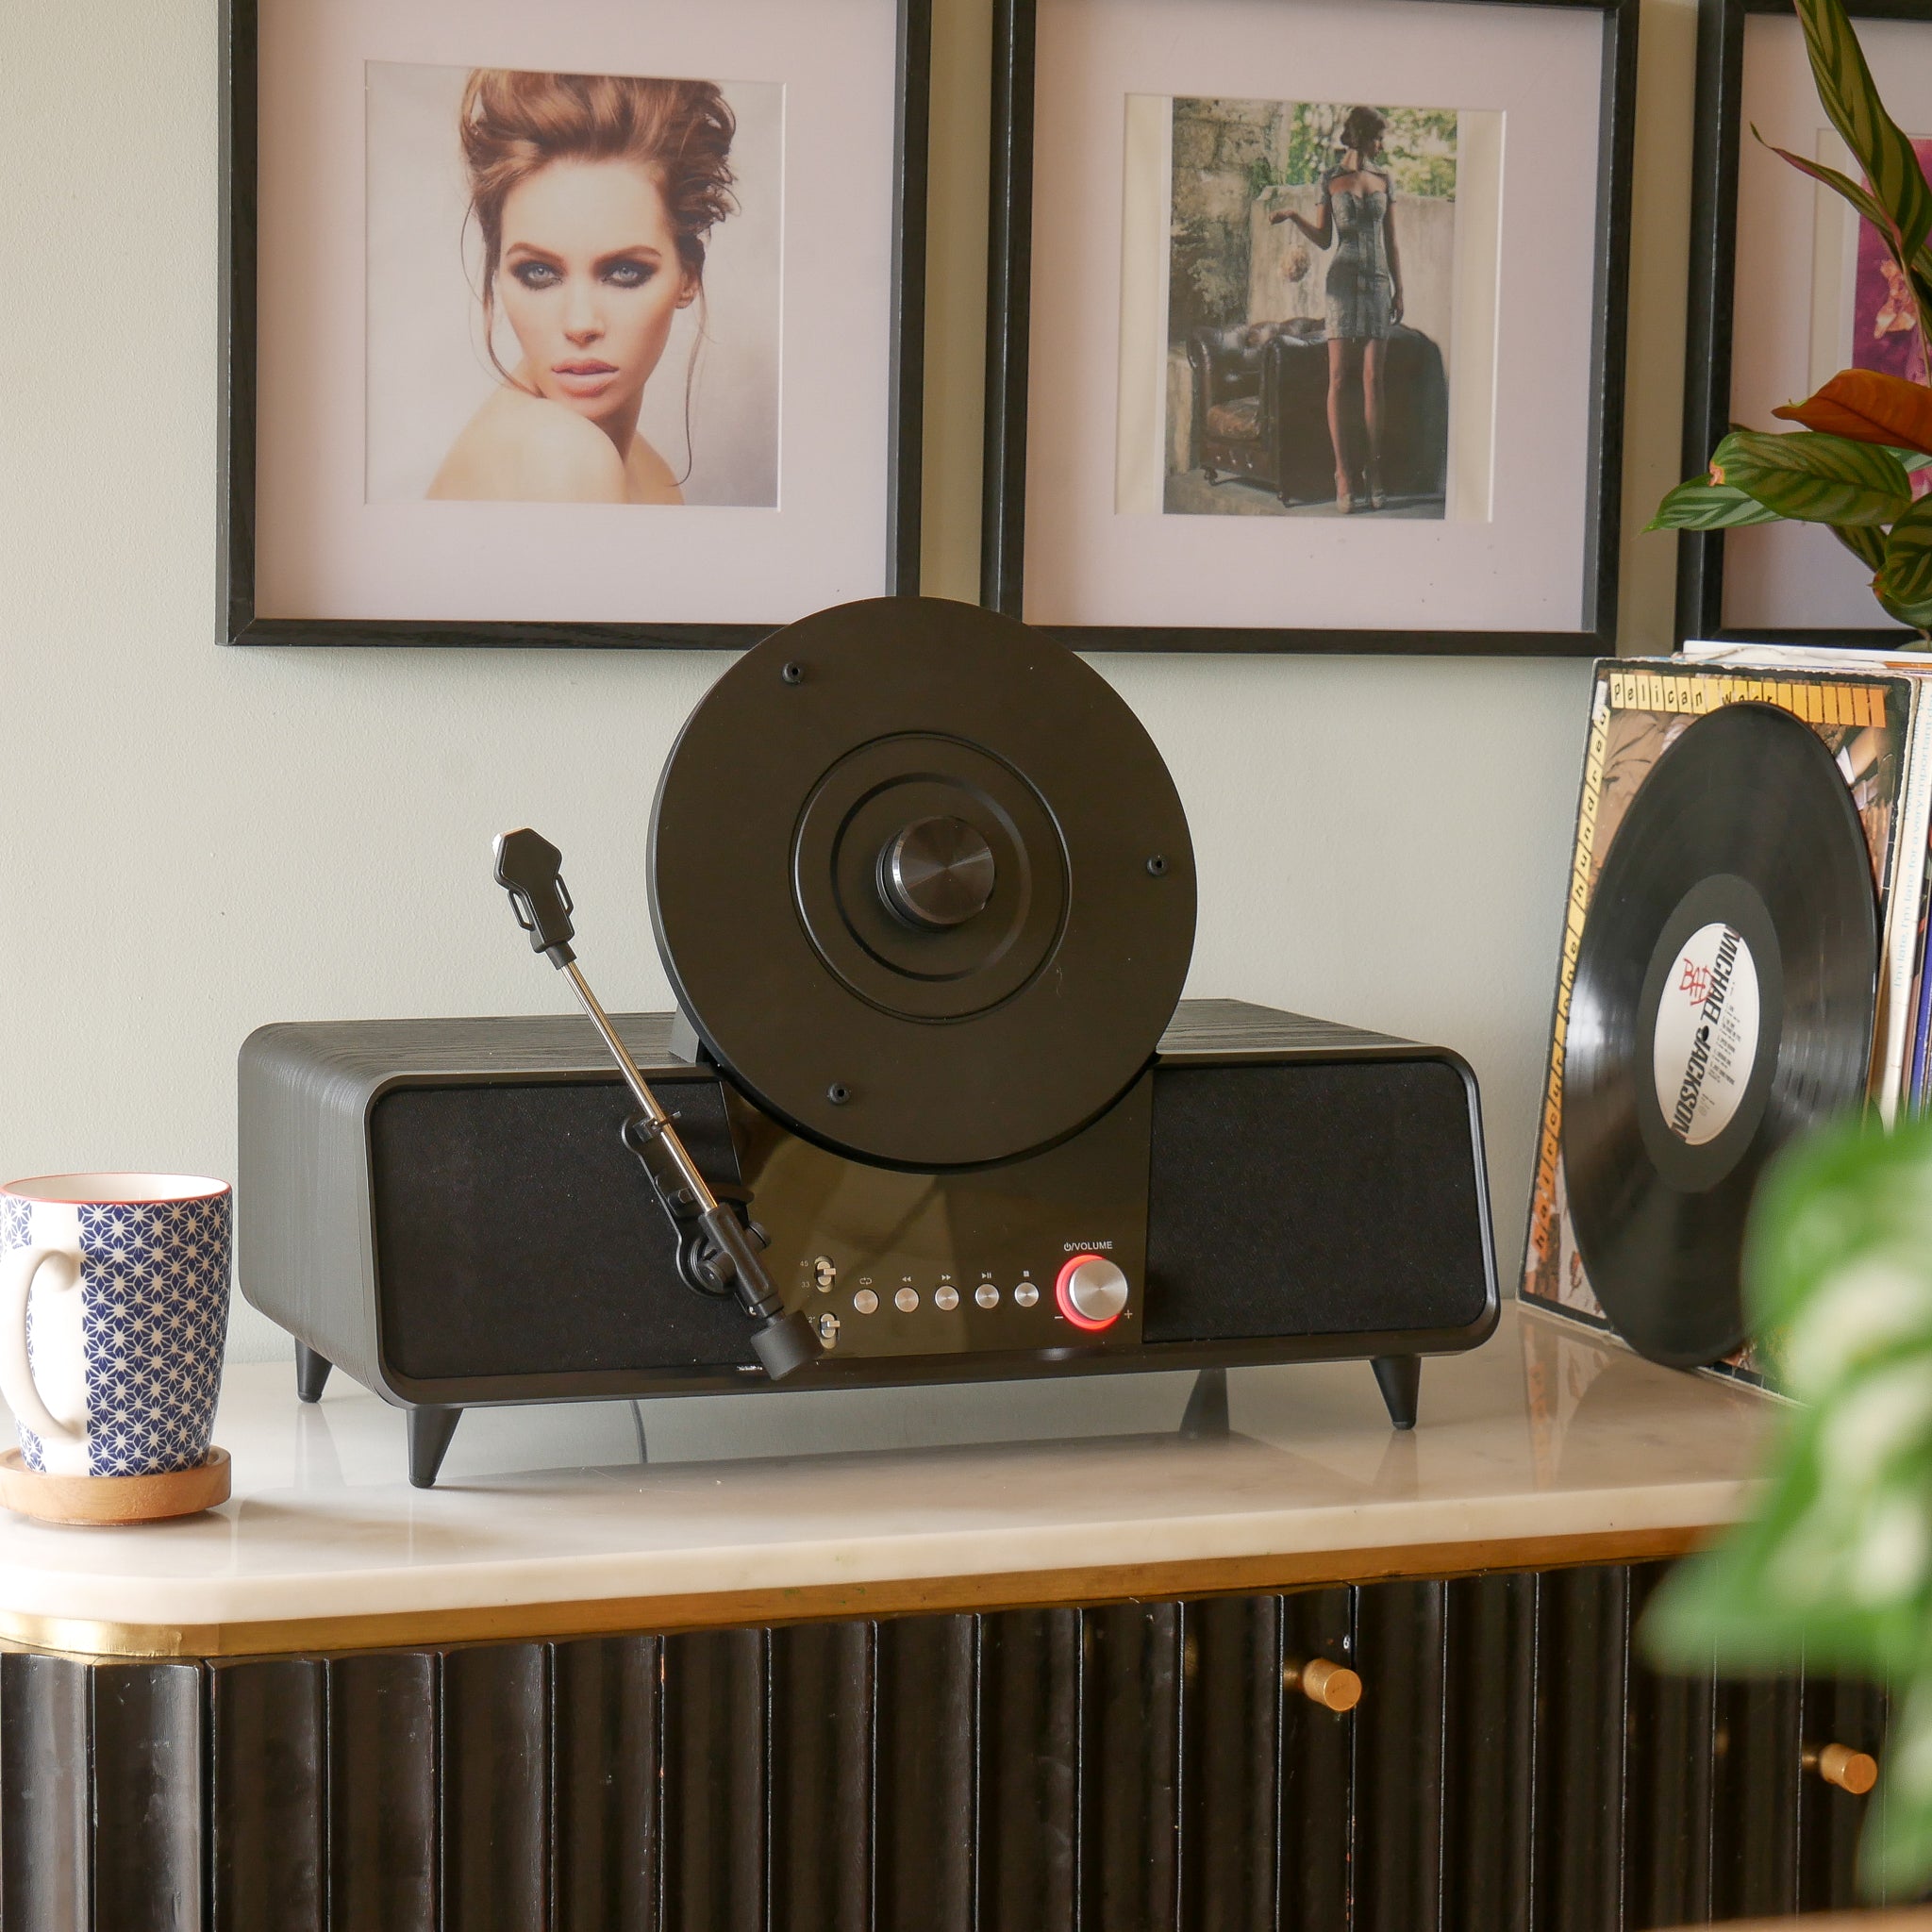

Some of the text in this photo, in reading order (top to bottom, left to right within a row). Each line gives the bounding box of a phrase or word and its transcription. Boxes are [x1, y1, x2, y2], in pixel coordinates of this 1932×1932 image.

[1918, 723, 1931, 796] important
[1912, 801, 1924, 831] very
[1912, 836, 1918, 845] a
[1907, 850, 1917, 868] for
[1904, 874, 1914, 902] late
[1901, 907, 1910, 928] I'm
[1700, 927, 1741, 1025] MICHAEL
[1893, 966, 1903, 988] I'm
[1672, 1028, 1712, 1136] JACKSON
